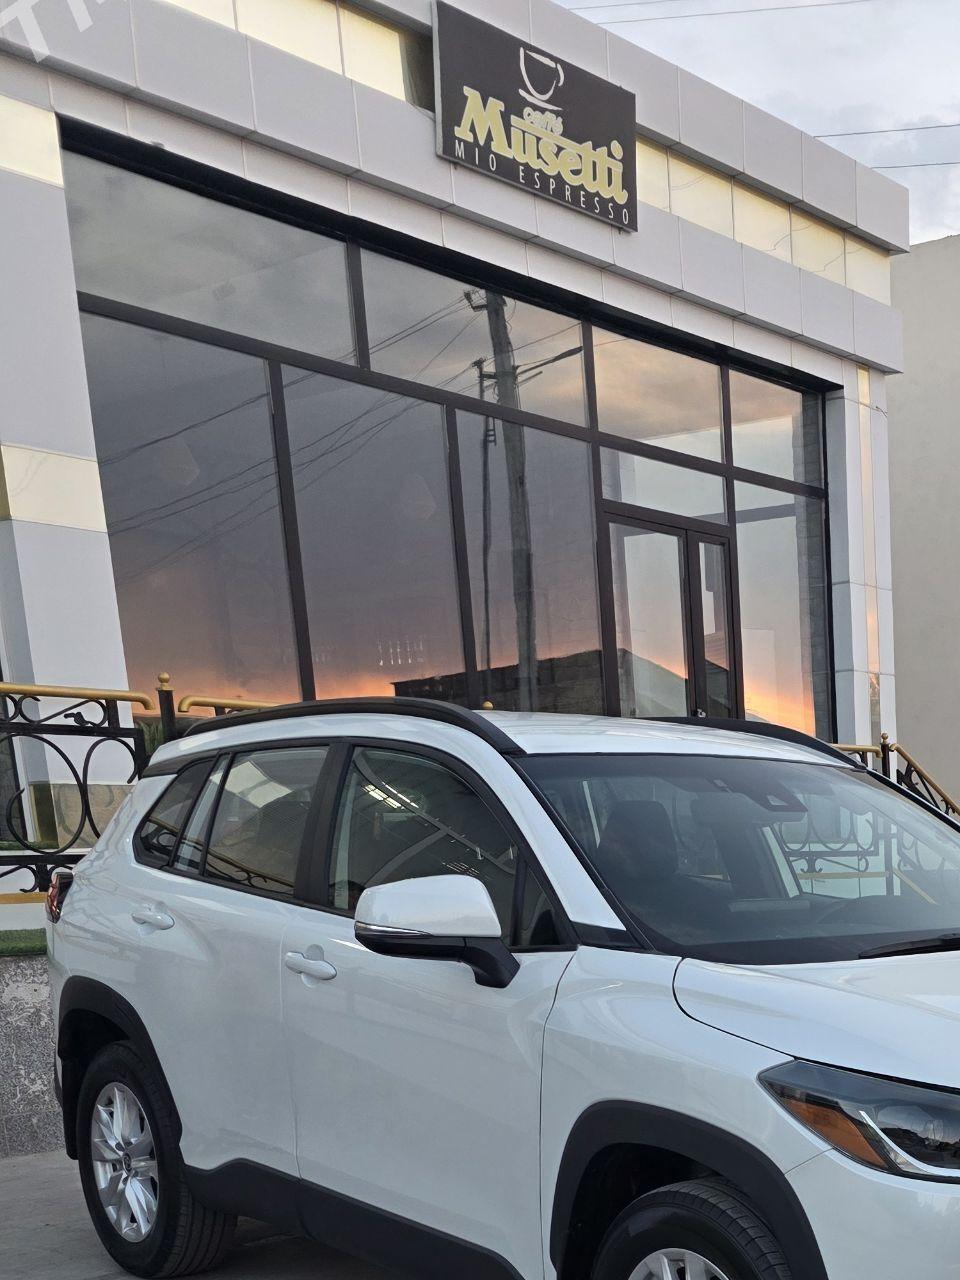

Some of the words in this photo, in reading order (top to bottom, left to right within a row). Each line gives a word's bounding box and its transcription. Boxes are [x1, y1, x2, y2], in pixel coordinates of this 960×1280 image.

[454, 85, 629, 205] Musetti
[454, 139, 497, 171] MIO
[518, 165, 630, 225] ESPRESSO
